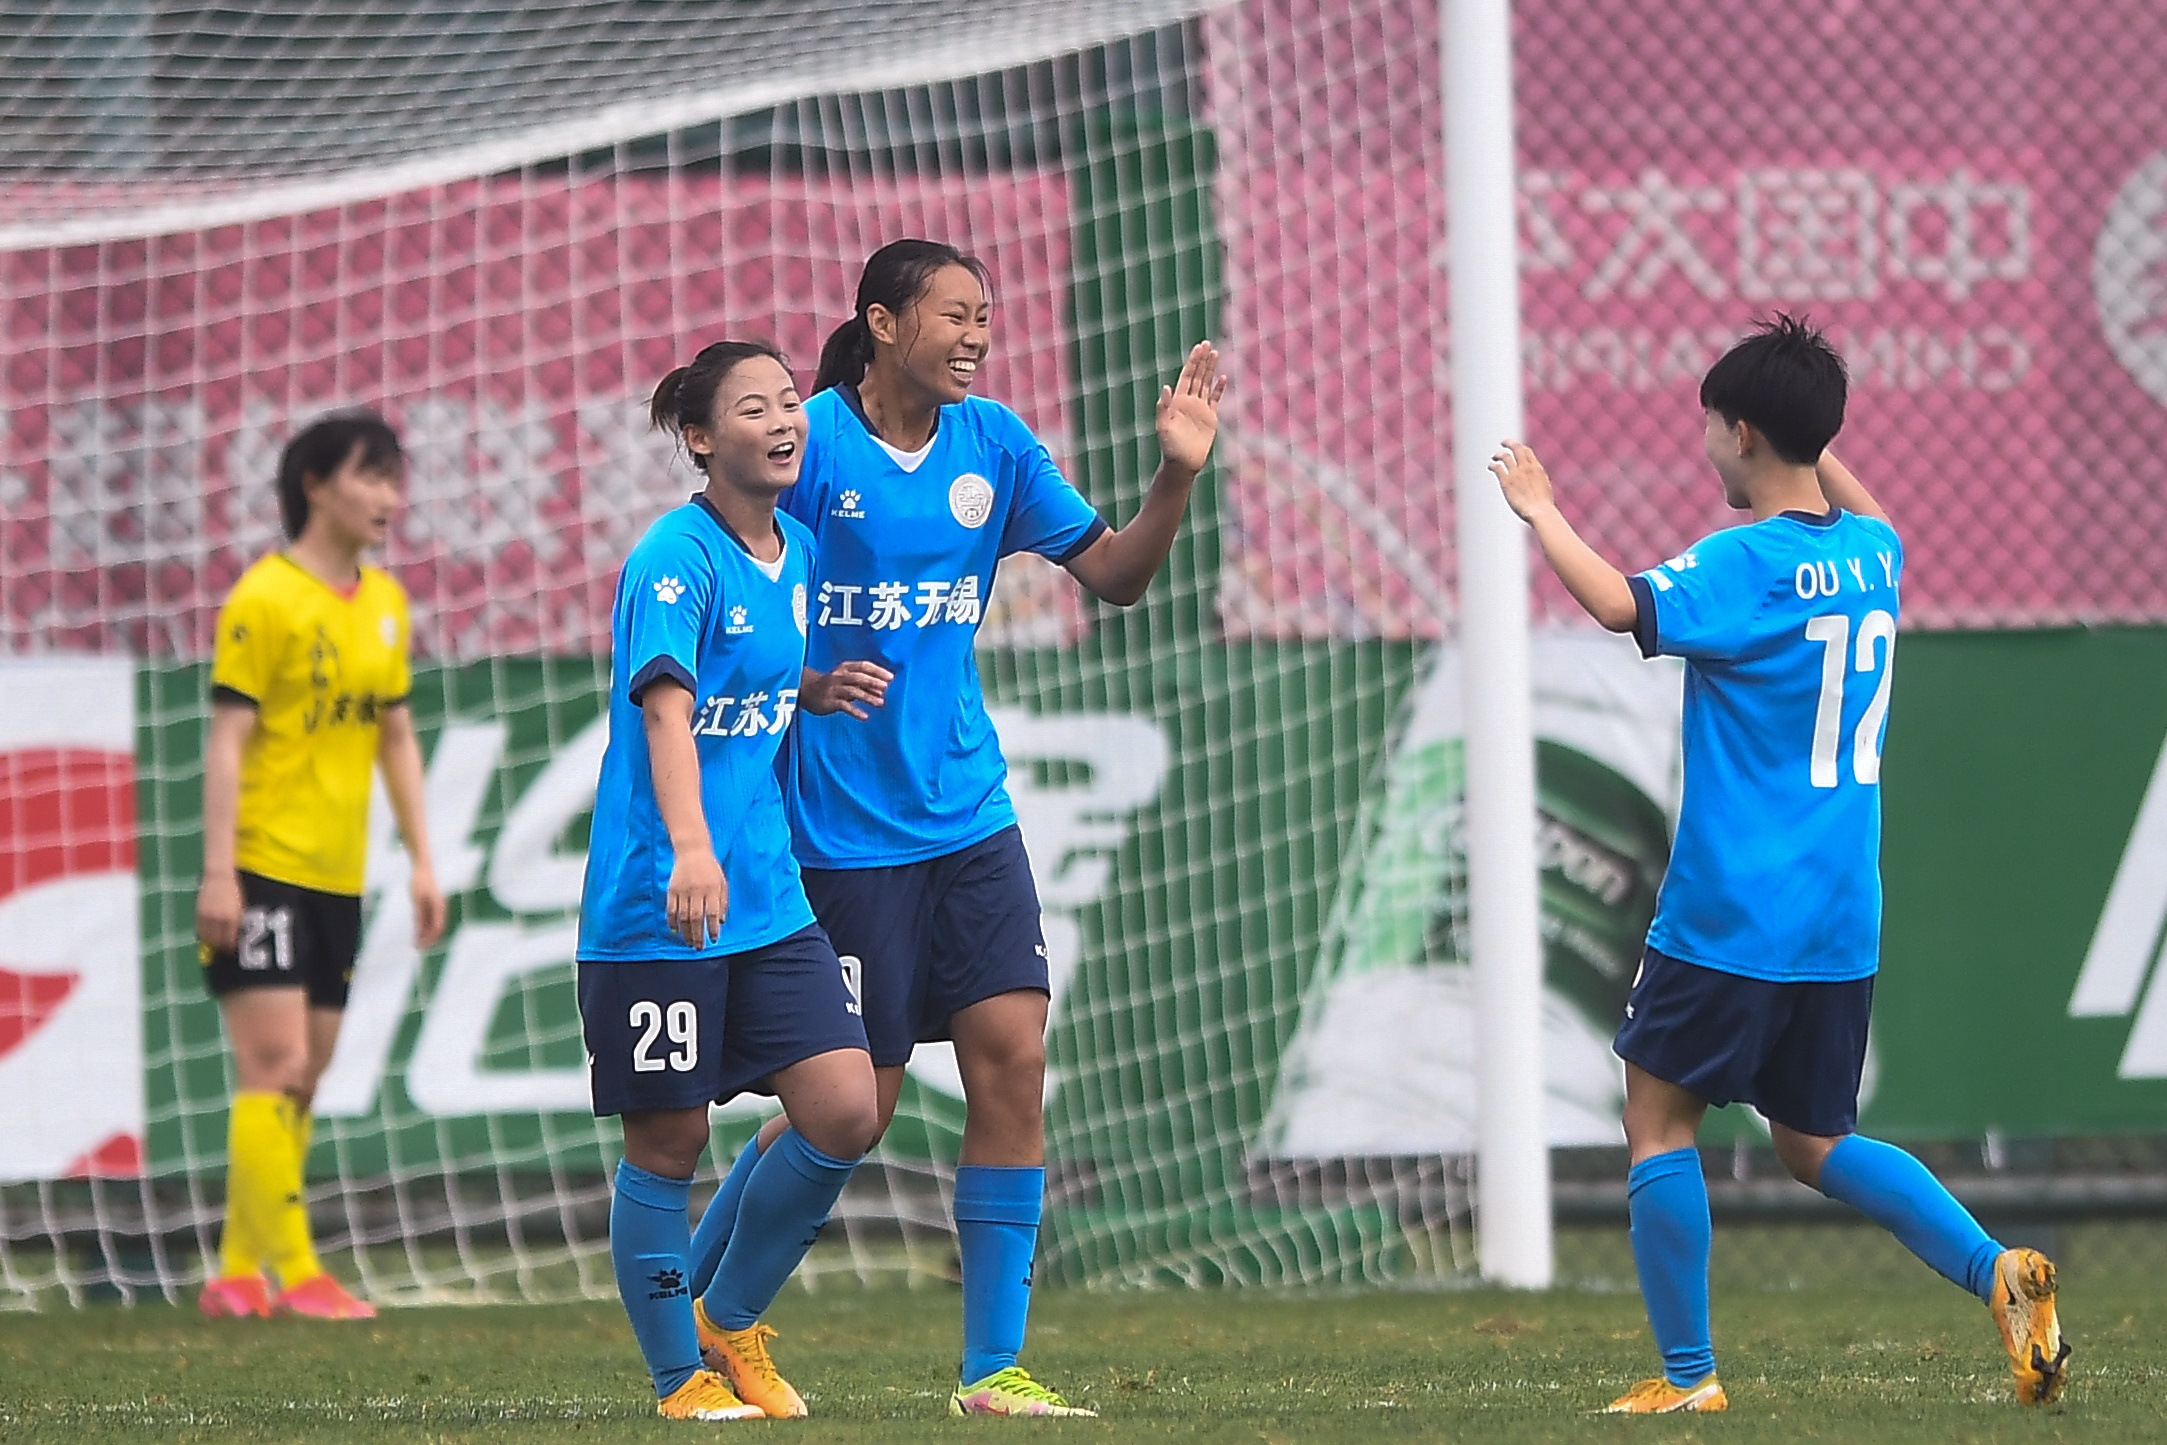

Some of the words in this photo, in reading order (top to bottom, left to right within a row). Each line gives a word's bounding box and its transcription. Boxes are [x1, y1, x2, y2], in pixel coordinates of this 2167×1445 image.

[830, 508, 866, 519] KELME
[817, 575, 981, 631] 江苏无锡
[1795, 560, 1841, 600] OU
[725, 624, 754, 634] KELME
[1805, 609, 1895, 788] 12
[237, 904, 297, 972] 21
[629, 1000, 699, 1073] 29
